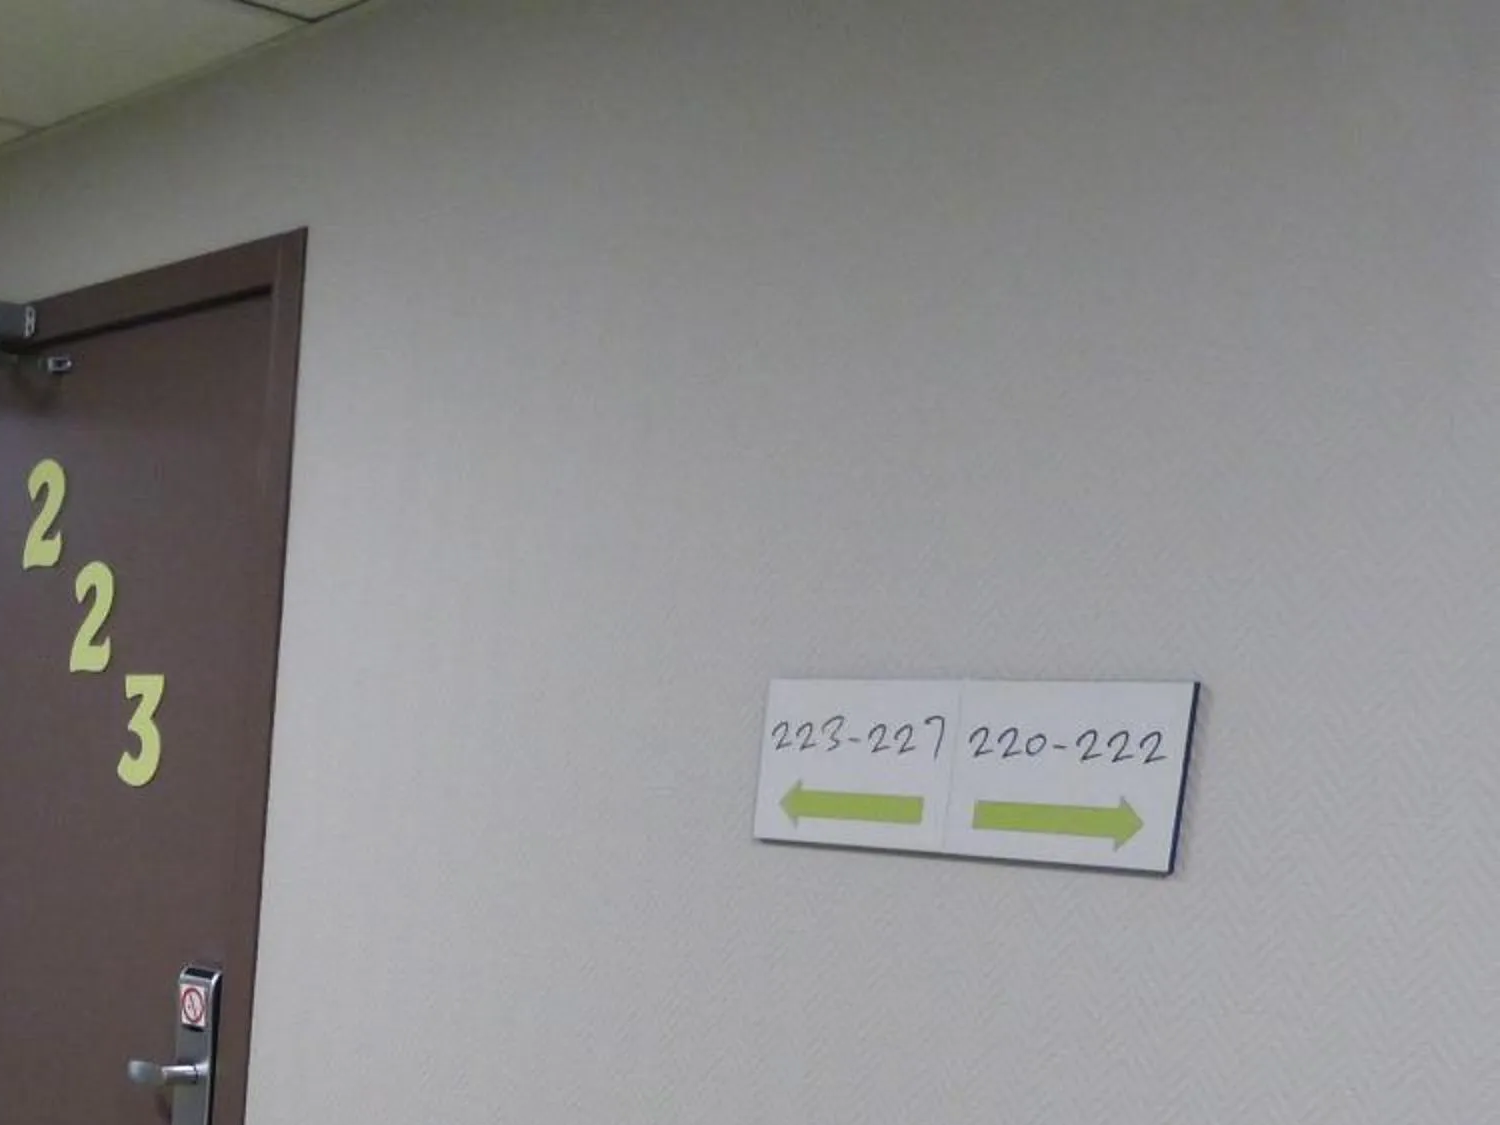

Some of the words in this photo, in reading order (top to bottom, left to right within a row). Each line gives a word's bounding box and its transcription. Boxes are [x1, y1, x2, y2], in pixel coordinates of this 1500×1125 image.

[22, 458, 164, 787] 223
[771, 714, 946, 762] 223-227
[968, 727, 1167, 764] 220-222
